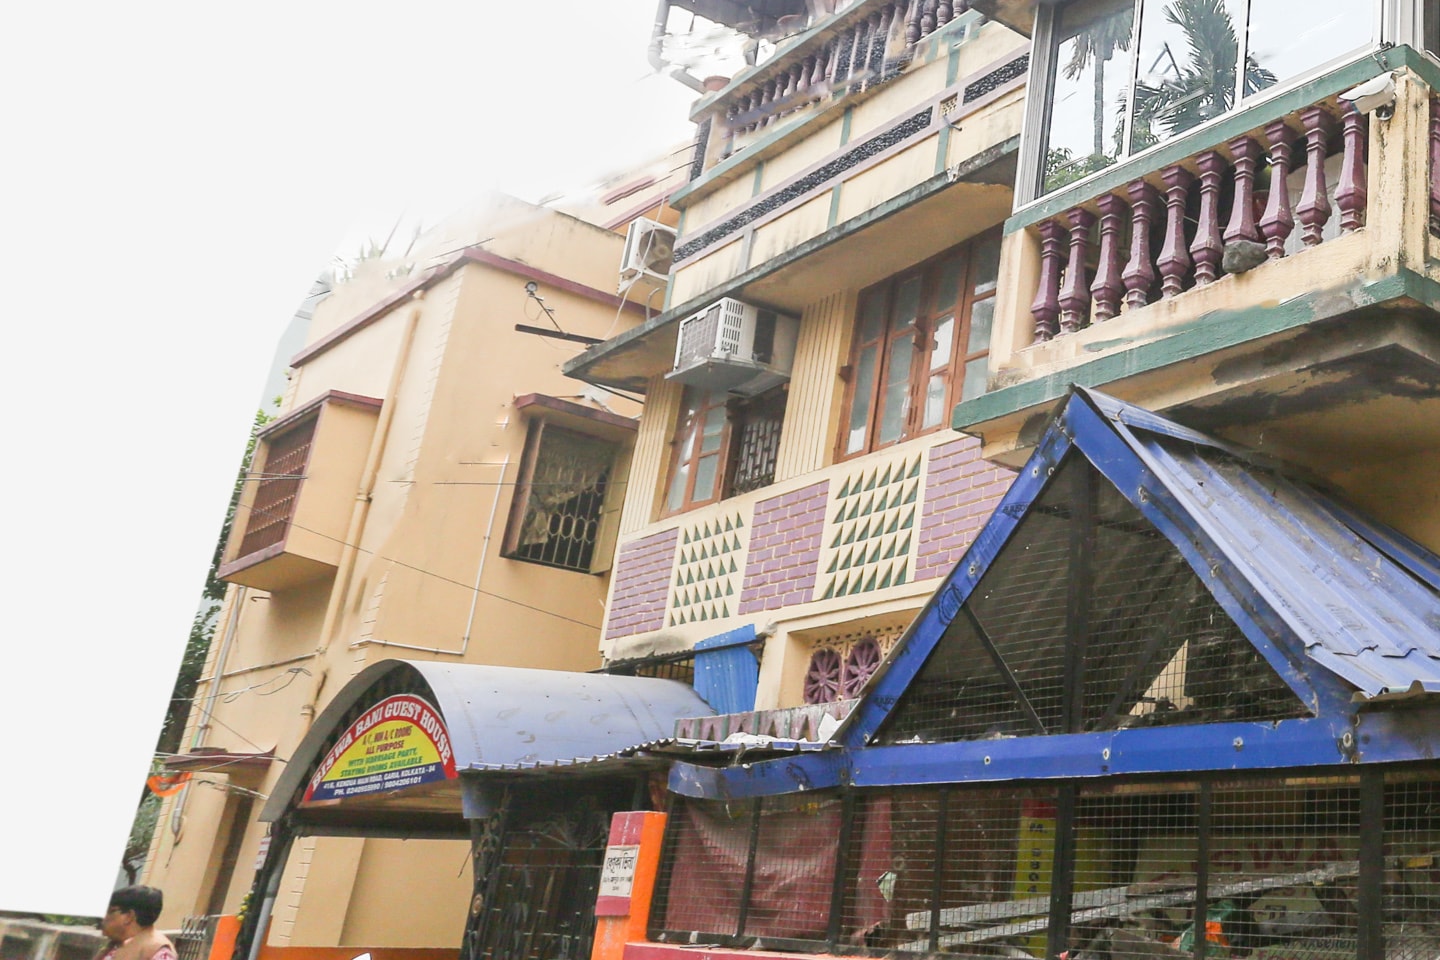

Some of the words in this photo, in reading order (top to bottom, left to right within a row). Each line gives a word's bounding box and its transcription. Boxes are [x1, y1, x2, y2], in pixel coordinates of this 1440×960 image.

[313, 733, 353, 790] BISWA
[356, 707, 384, 736] BANI
[384, 701, 422, 720] GUEST
[419, 711, 451, 766] HOUSE
[366, 747, 376, 756] ALL
[376, 740, 404, 753] PURPOSE
[389, 756, 423, 770] AVAILABLE
